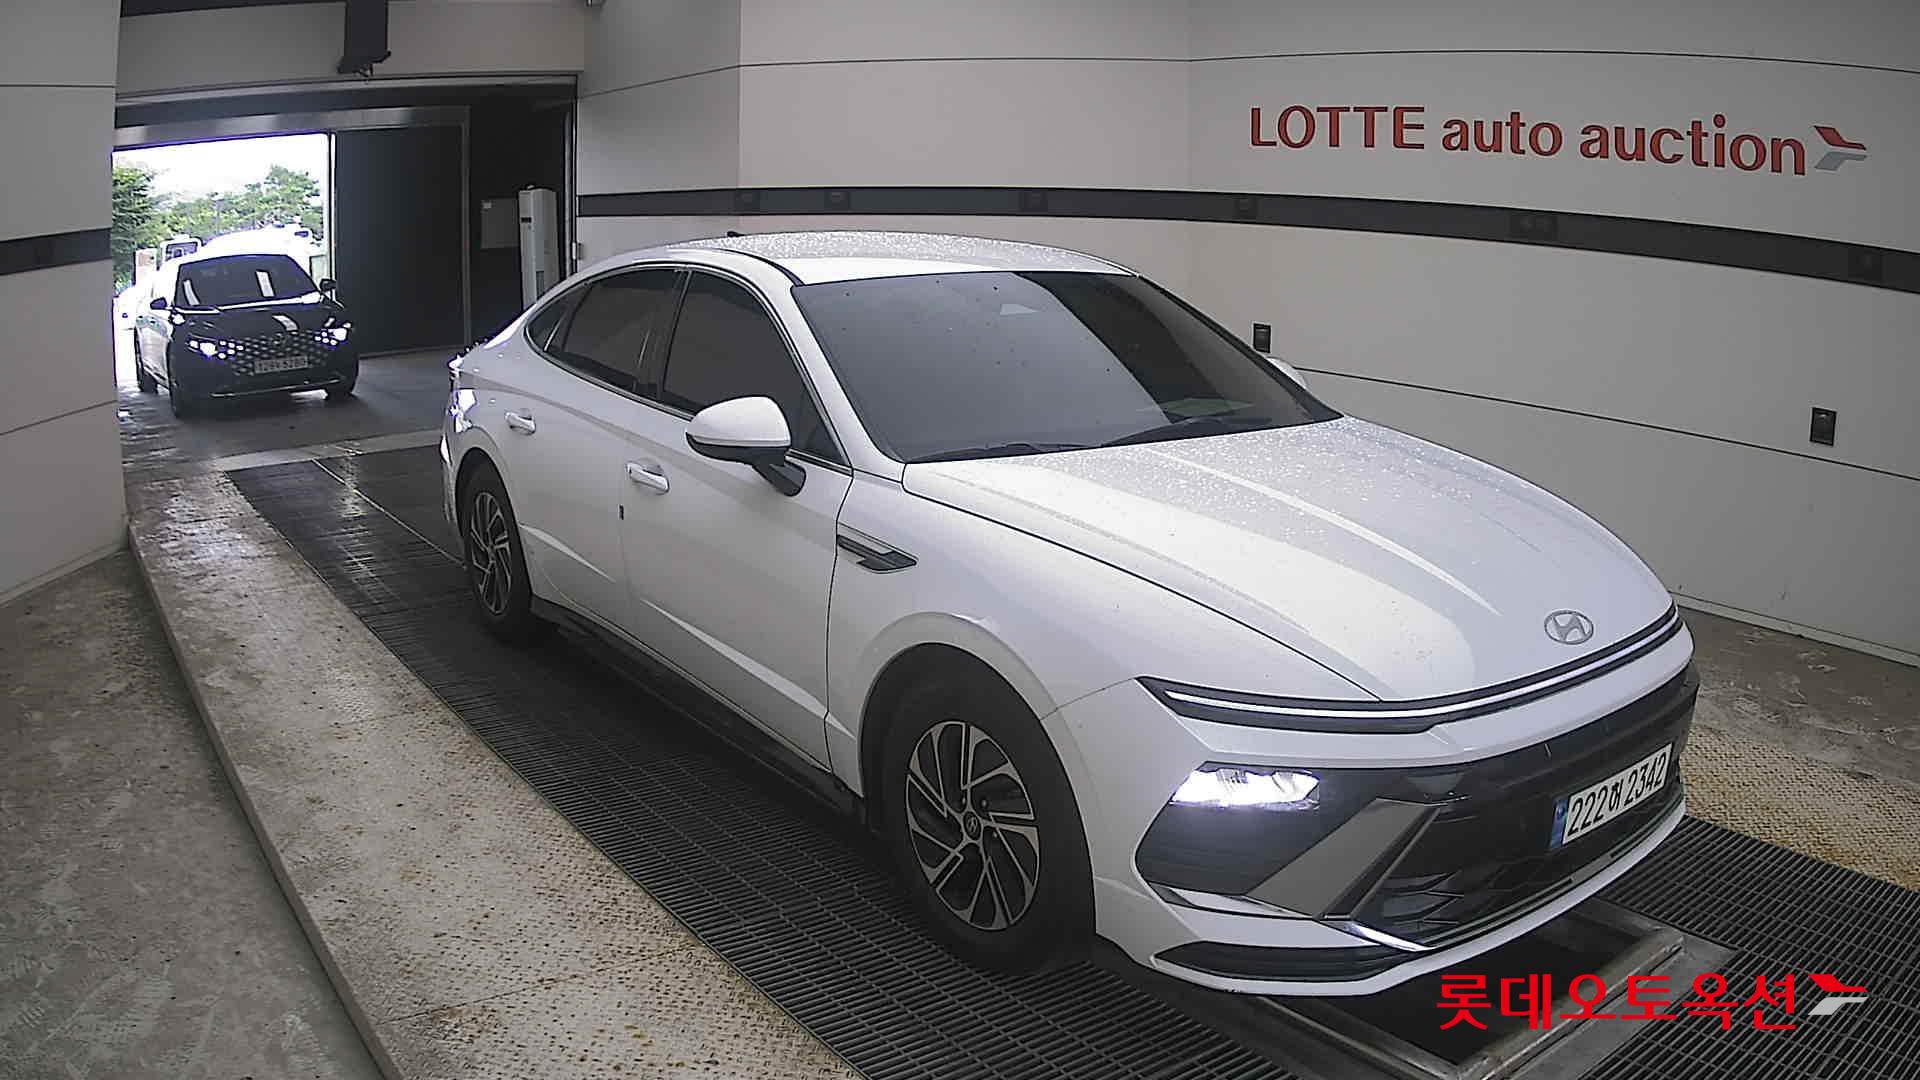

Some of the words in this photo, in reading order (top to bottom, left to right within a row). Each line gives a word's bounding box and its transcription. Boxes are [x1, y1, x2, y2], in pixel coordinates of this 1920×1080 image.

[1250, 105, 1425, 149] LOTTE
[1442, 111, 1563, 157] auto
[1579, 114, 1807, 176] auction
[1624, 751, 1667, 807] 2342
